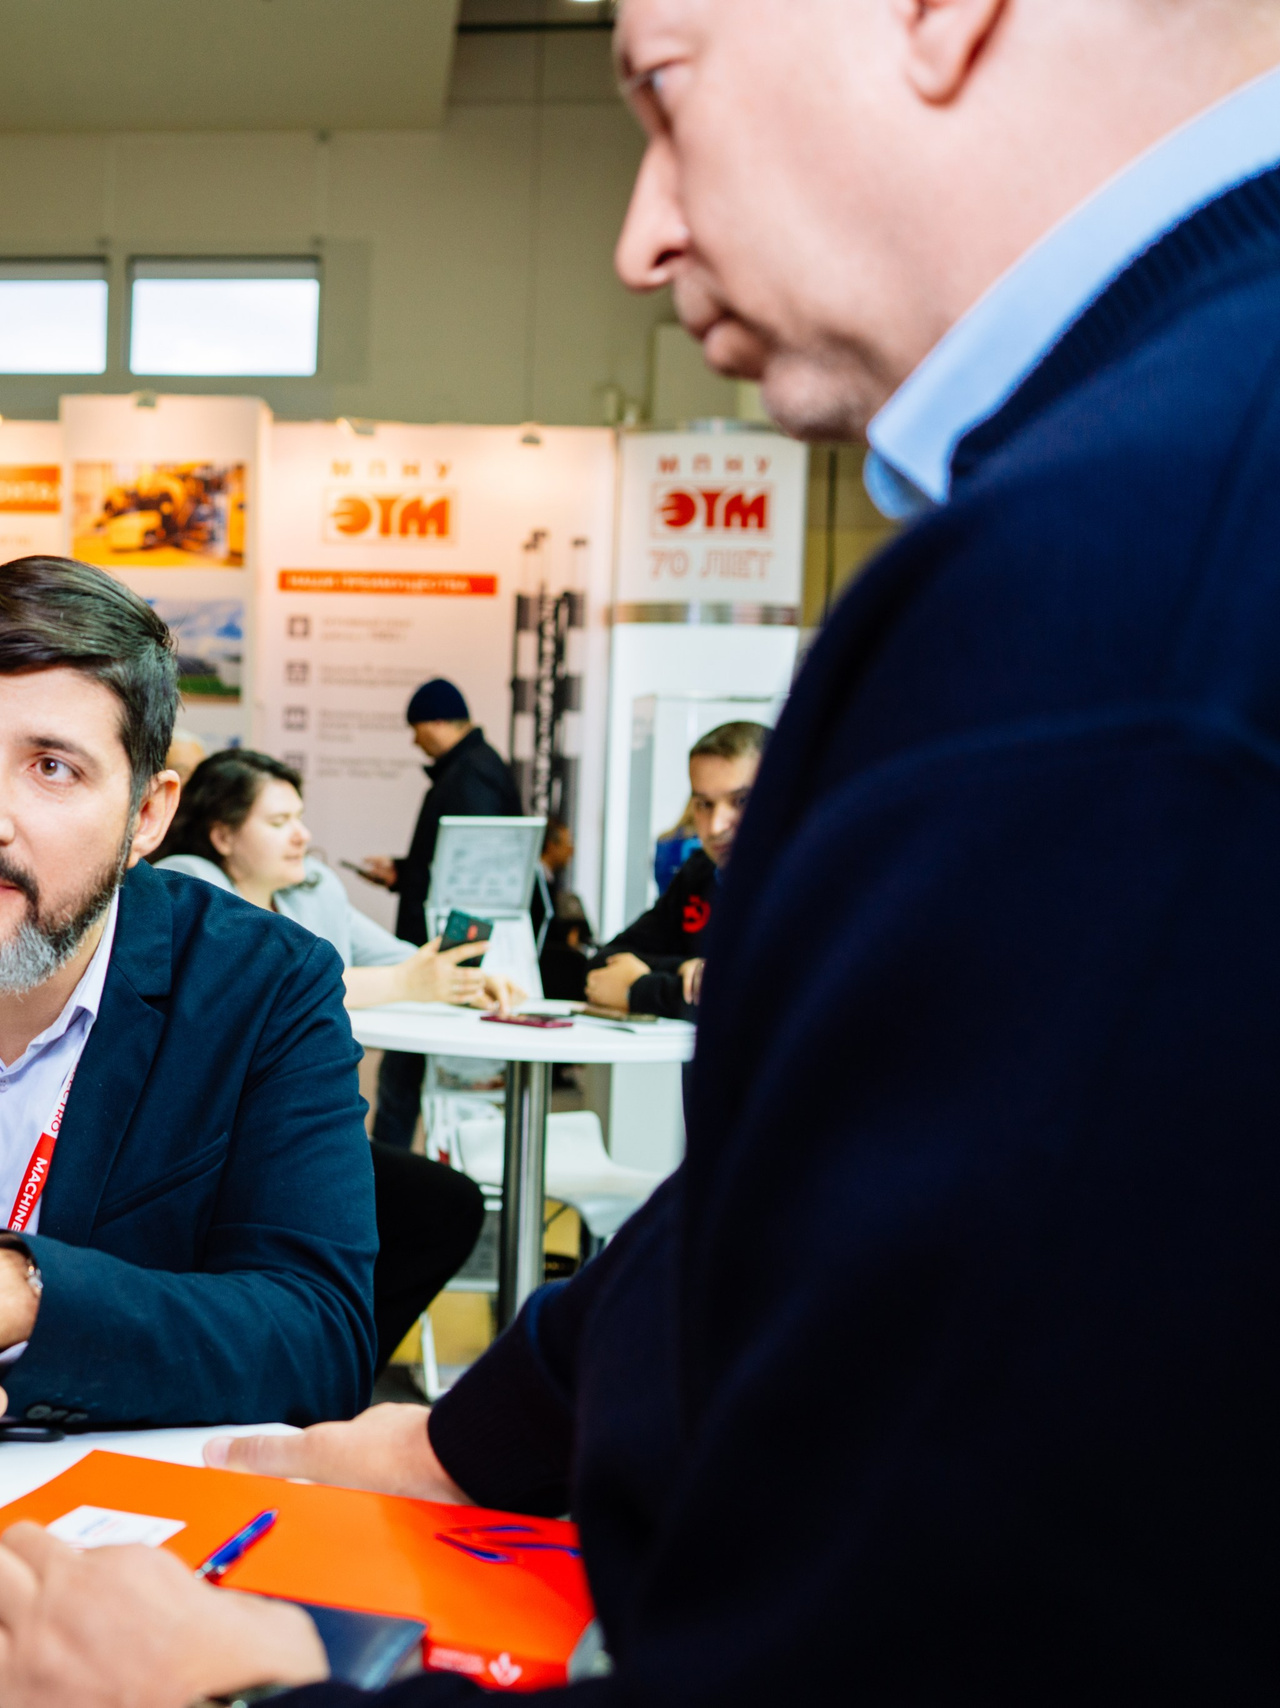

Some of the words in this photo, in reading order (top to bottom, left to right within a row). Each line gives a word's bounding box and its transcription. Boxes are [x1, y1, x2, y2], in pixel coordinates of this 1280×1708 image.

[330, 494, 449, 538] ЭТМ
[656, 488, 767, 531] ЭТМ
[10, 1156, 48, 1232] MACHINE
